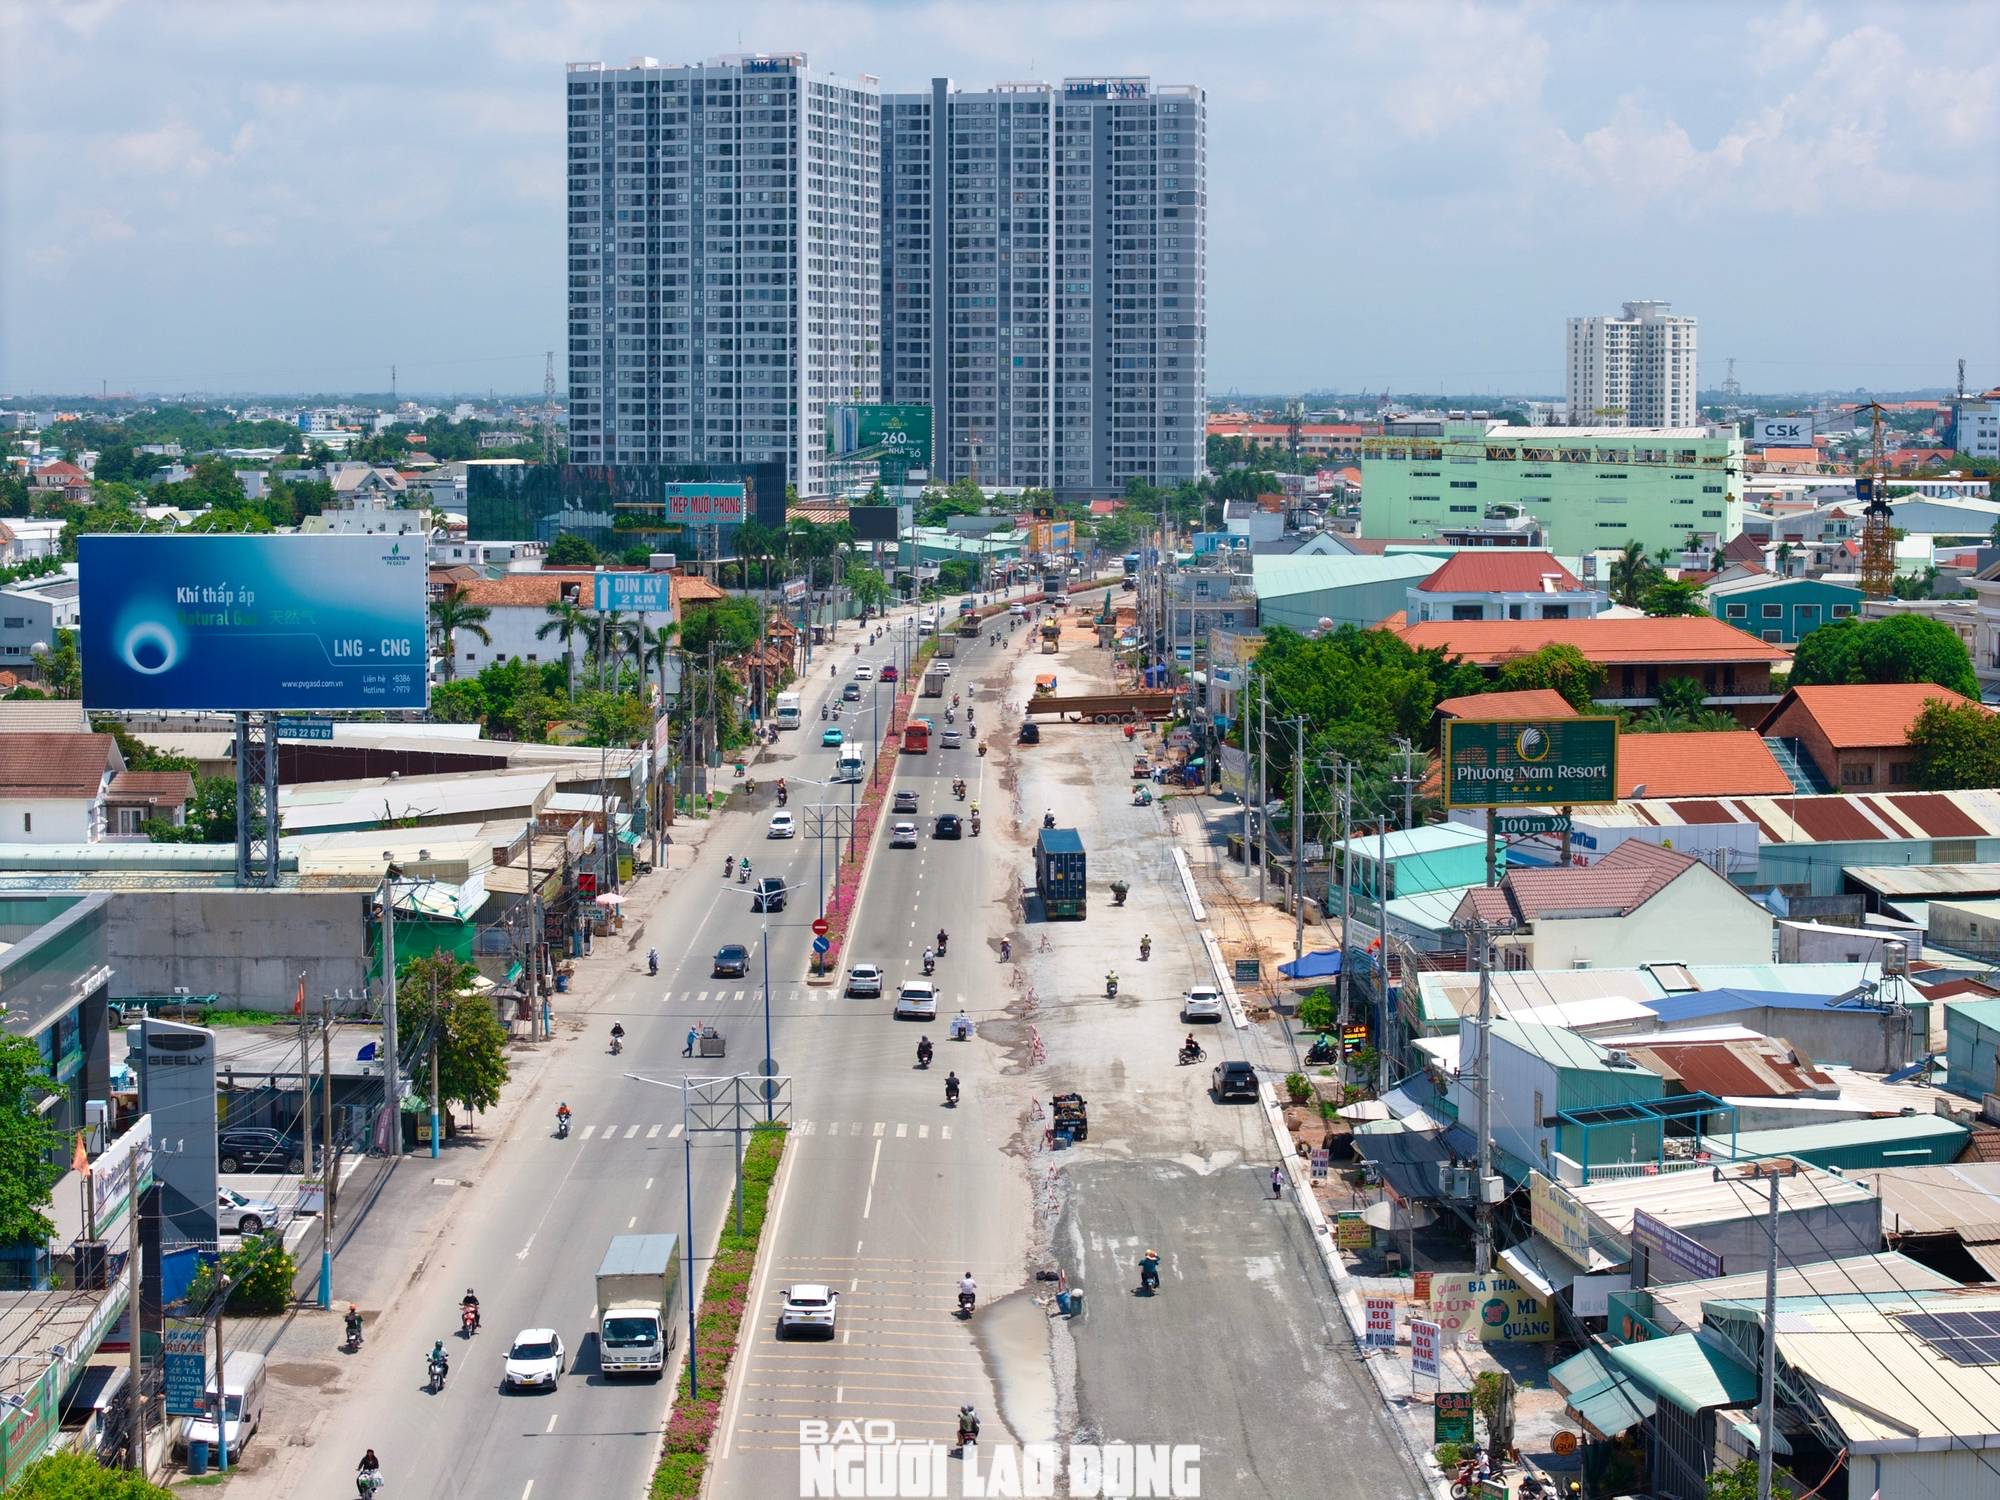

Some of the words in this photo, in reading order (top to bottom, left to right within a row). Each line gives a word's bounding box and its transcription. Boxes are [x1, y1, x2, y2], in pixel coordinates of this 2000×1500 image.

[1765, 425, 1800, 437] CSK
[881, 432, 907, 444] 260
[889, 446, 905, 455] NHÀ
[669, 493, 689, 513] THÉP
[714, 497, 741, 514] PHONG
[615, 576, 640, 593] DÌN
[645, 576, 662, 593] KÝ
[177, 585, 200, 603] Khí
[202, 582, 234, 607] thấp
[239, 585, 255, 607] áp
[622, 595, 630, 604] 2
[634, 595, 656, 604] KM
[177, 610, 229, 626] Natural
[234, 610, 259, 626] Gas
[269, 610, 317, 626] 天然气
[334, 639, 363, 657] LNG
[381, 639, 411, 657] CNG
[363, 675, 377, 683] Liên
[363, 686, 386, 694] Hotline
[279, 728, 298, 737] 0975
[299, 728, 309, 738] 22
[311, 729, 320, 738] 67
[322, 729, 332, 738] 67
[1519, 766, 1553, 779] Nam
[1558, 764, 1608, 779] Resort
[1500, 819, 1530, 833] 100
[1532, 822, 1547, 832] m
[1572, 854, 1589, 867] SALE
[148, 1055, 206, 1066] GEELY
[1468, 1278, 1487, 1293] BÀ
[1367, 1299, 1394, 1310] BÚN
[1433, 1298, 1476, 1313] BÚN
[1372, 1309, 1389, 1320] BÒ
[1367, 1319, 1393, 1330] HUẾ
[1412, 1323, 1435, 1338] BÚN
[1503, 1317, 1551, 1340] QUẢNG
[1366, 1331, 1374, 1346] MÌ
[1375, 1330, 1395, 1347] QUẢNG
[1416, 1336, 1431, 1348] BÒ
[167, 1341, 189, 1354] RỬA
[190, 1344, 203, 1354] XE
[1413, 1347, 1435, 1361] HUẾ
[1420, 1360, 1437, 1374] QUẢNG
[169, 1375, 201, 1383] HONDA
[1437, 1394, 1473, 1409] Gùi
[1440, 1409, 1469, 1418] Coffee
